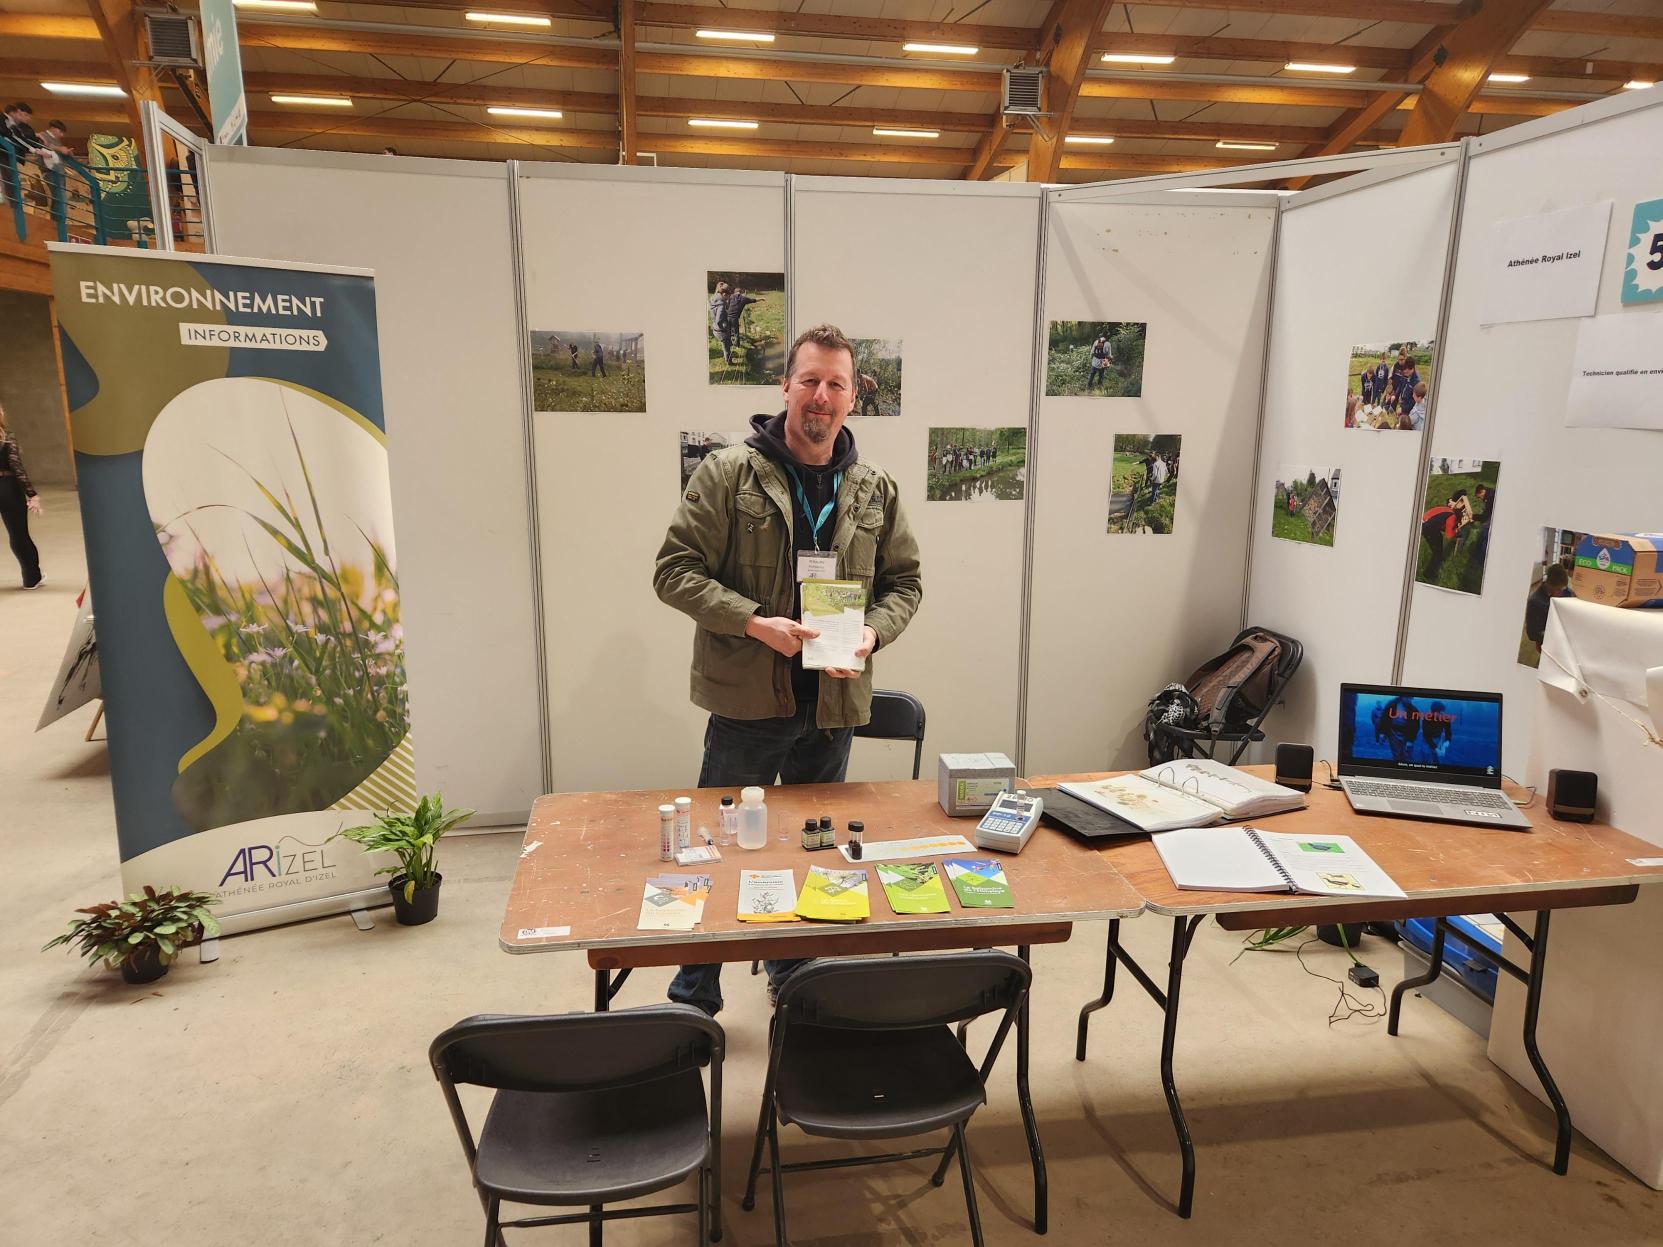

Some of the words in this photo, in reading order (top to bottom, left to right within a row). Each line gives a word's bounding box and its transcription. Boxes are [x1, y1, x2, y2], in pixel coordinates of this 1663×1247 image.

[1541, 252, 1564, 263] Royal
[1566, 250, 1581, 260] Izel
[79, 280, 324, 317] ENVIRONNEMENT
[188, 328, 321, 347] INFORMATIONS
[1388, 707, 1408, 720] Un
[215, 883, 264, 898] ATHÉNÉE
[268, 878, 301, 889] ROYAL
[305, 872, 337, 883] D'IZEL
